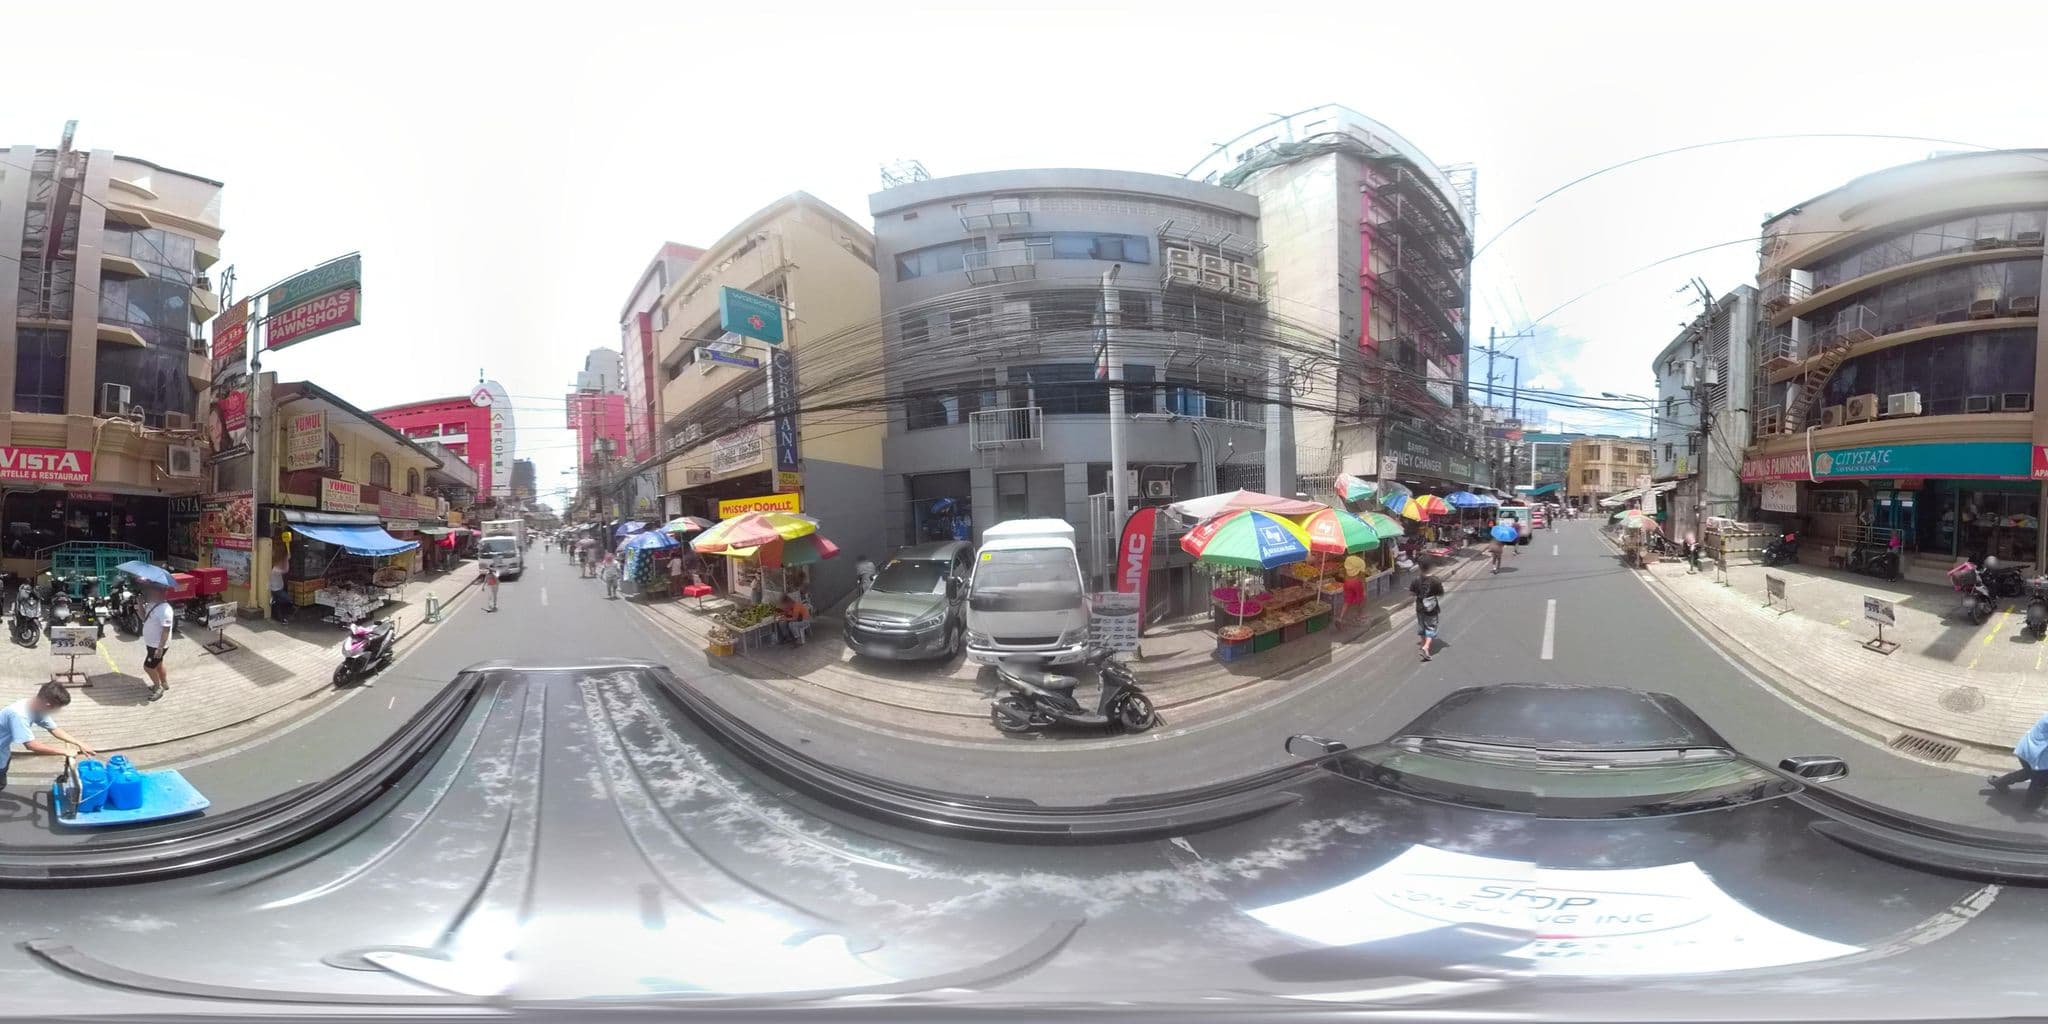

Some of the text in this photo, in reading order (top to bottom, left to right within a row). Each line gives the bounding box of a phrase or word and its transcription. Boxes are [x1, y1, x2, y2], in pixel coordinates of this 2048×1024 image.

[269, 292, 351, 330] FILIPINAS
[270, 304, 348, 341] PAWNSHOP
[774, 351, 794, 464] CEBUANA
[295, 413, 321, 432] YUMUL
[1835, 450, 1893, 465] CITYSTATE
[39, 471, 89, 482] RESTAURANT
[328, 480, 355, 494] YUMUL
[1126, 533, 1146, 593] JMC
